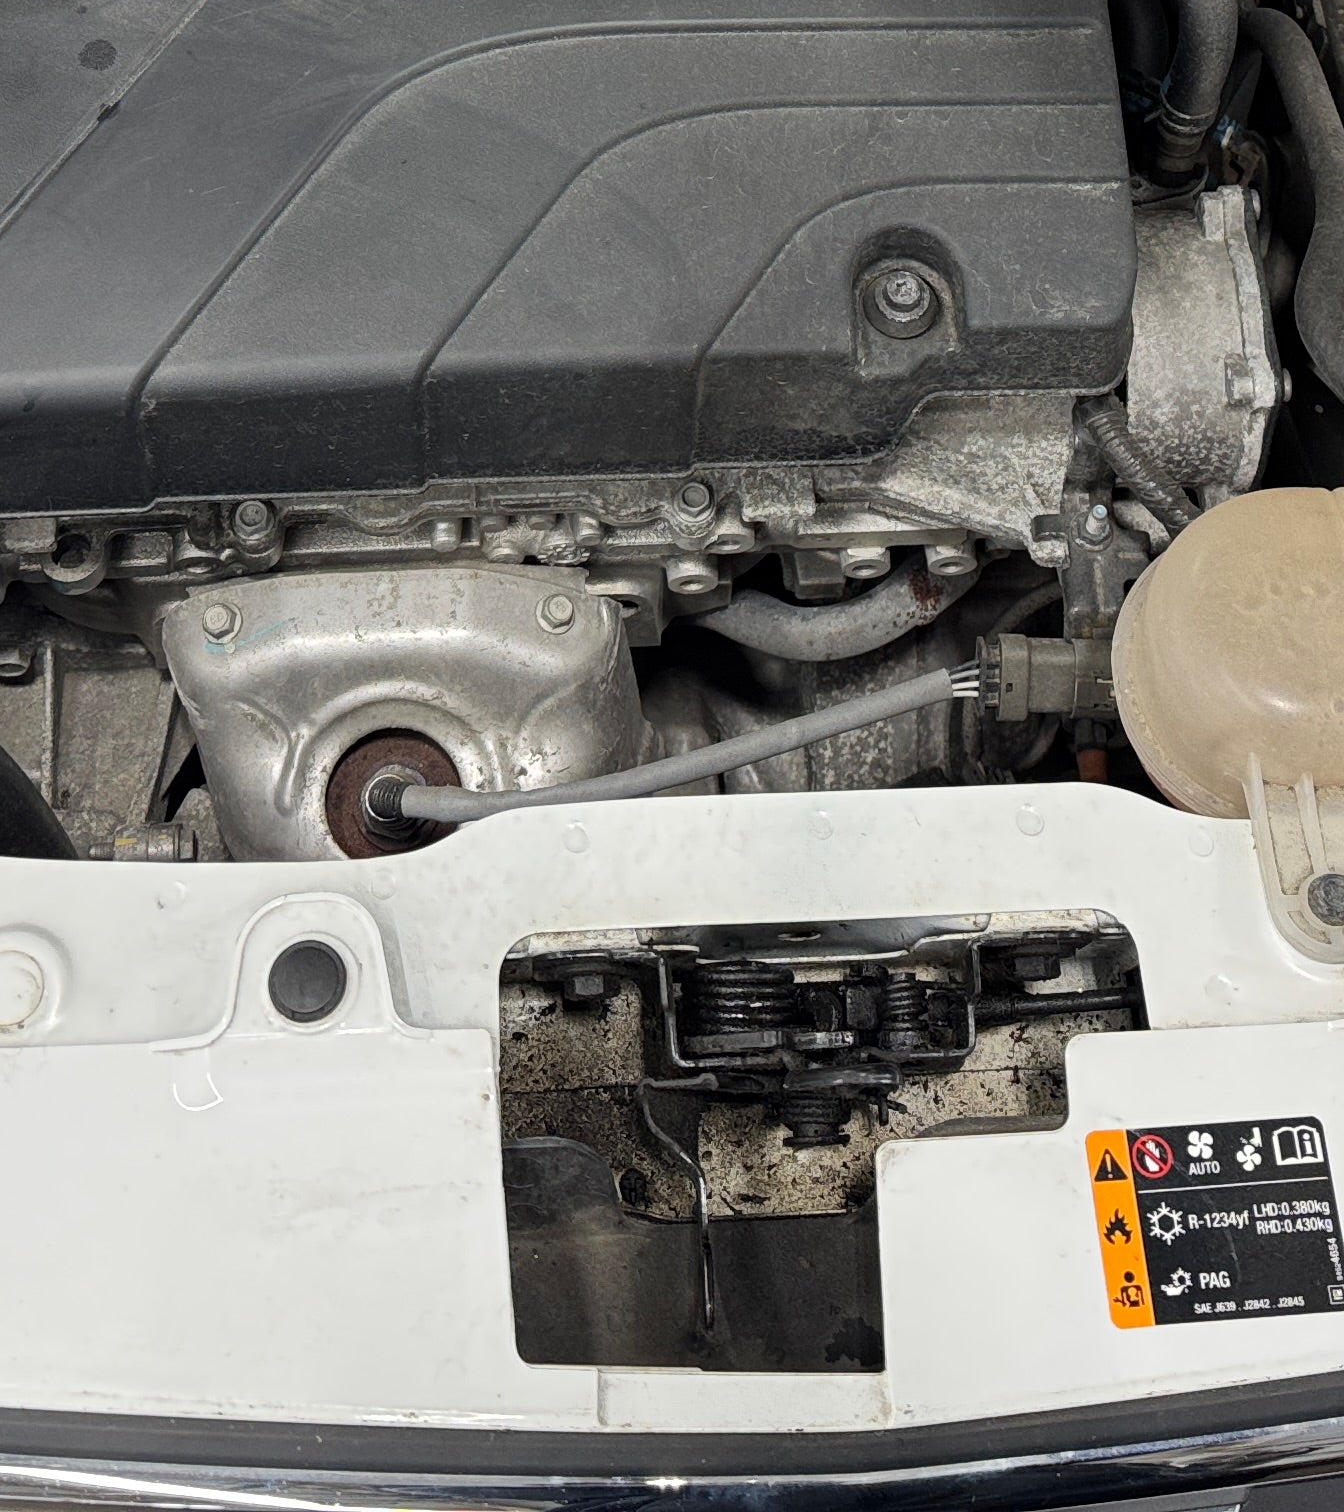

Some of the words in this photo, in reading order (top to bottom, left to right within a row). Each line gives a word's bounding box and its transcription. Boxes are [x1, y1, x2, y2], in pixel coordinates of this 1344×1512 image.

[1188, 1161, 1220, 1175] AUTO
[1253, 1200, 1331, 1219] LHD:0.380kg
[1188, 1210, 1250, 1230] R-1234yf
[1256, 1217, 1334, 1235] RHD:0.430kg
[1199, 1270, 1231, 1289] PAG
[1193, 1302, 1213, 1314] SAE
